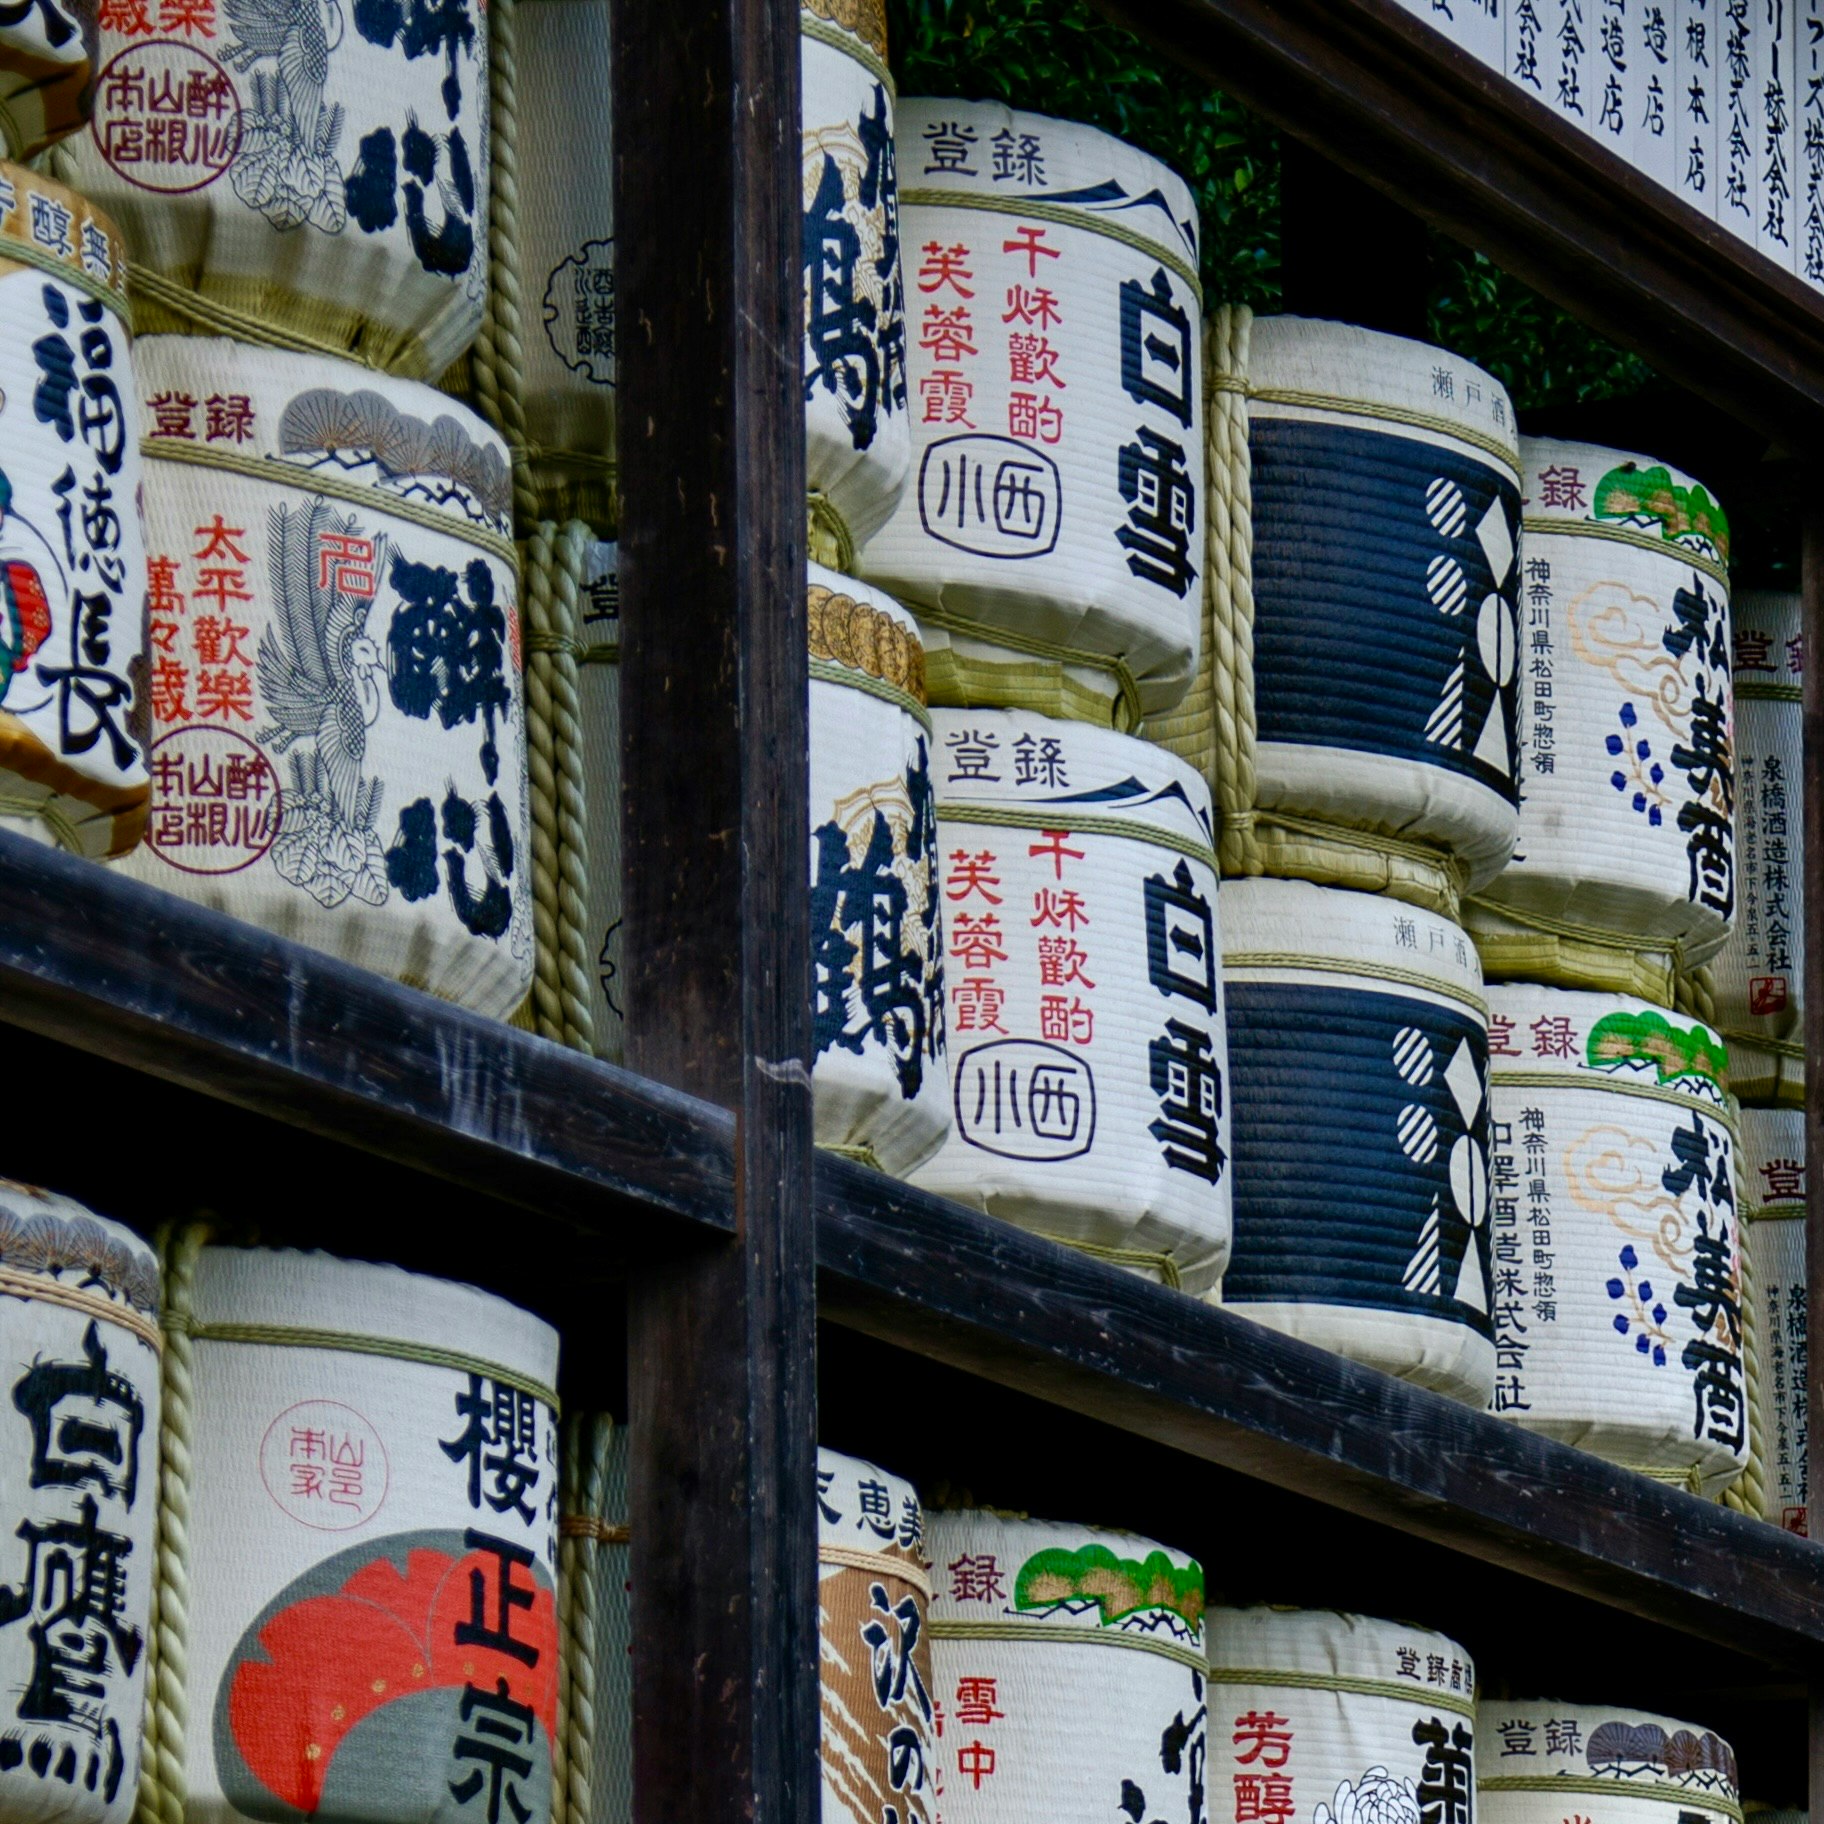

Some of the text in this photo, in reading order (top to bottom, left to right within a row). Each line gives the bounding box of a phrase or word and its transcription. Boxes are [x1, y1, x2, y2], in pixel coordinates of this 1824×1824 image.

[1113, 266, 1199, 600] 白雪
[1759, 754, 1793, 975] 泉橋酒造株式会社
[1143, 858, 1228, 1186] 白雪
[955, 1676, 1006, 1790] 雪中
[1495, 1718, 1583, 1758] 登録
